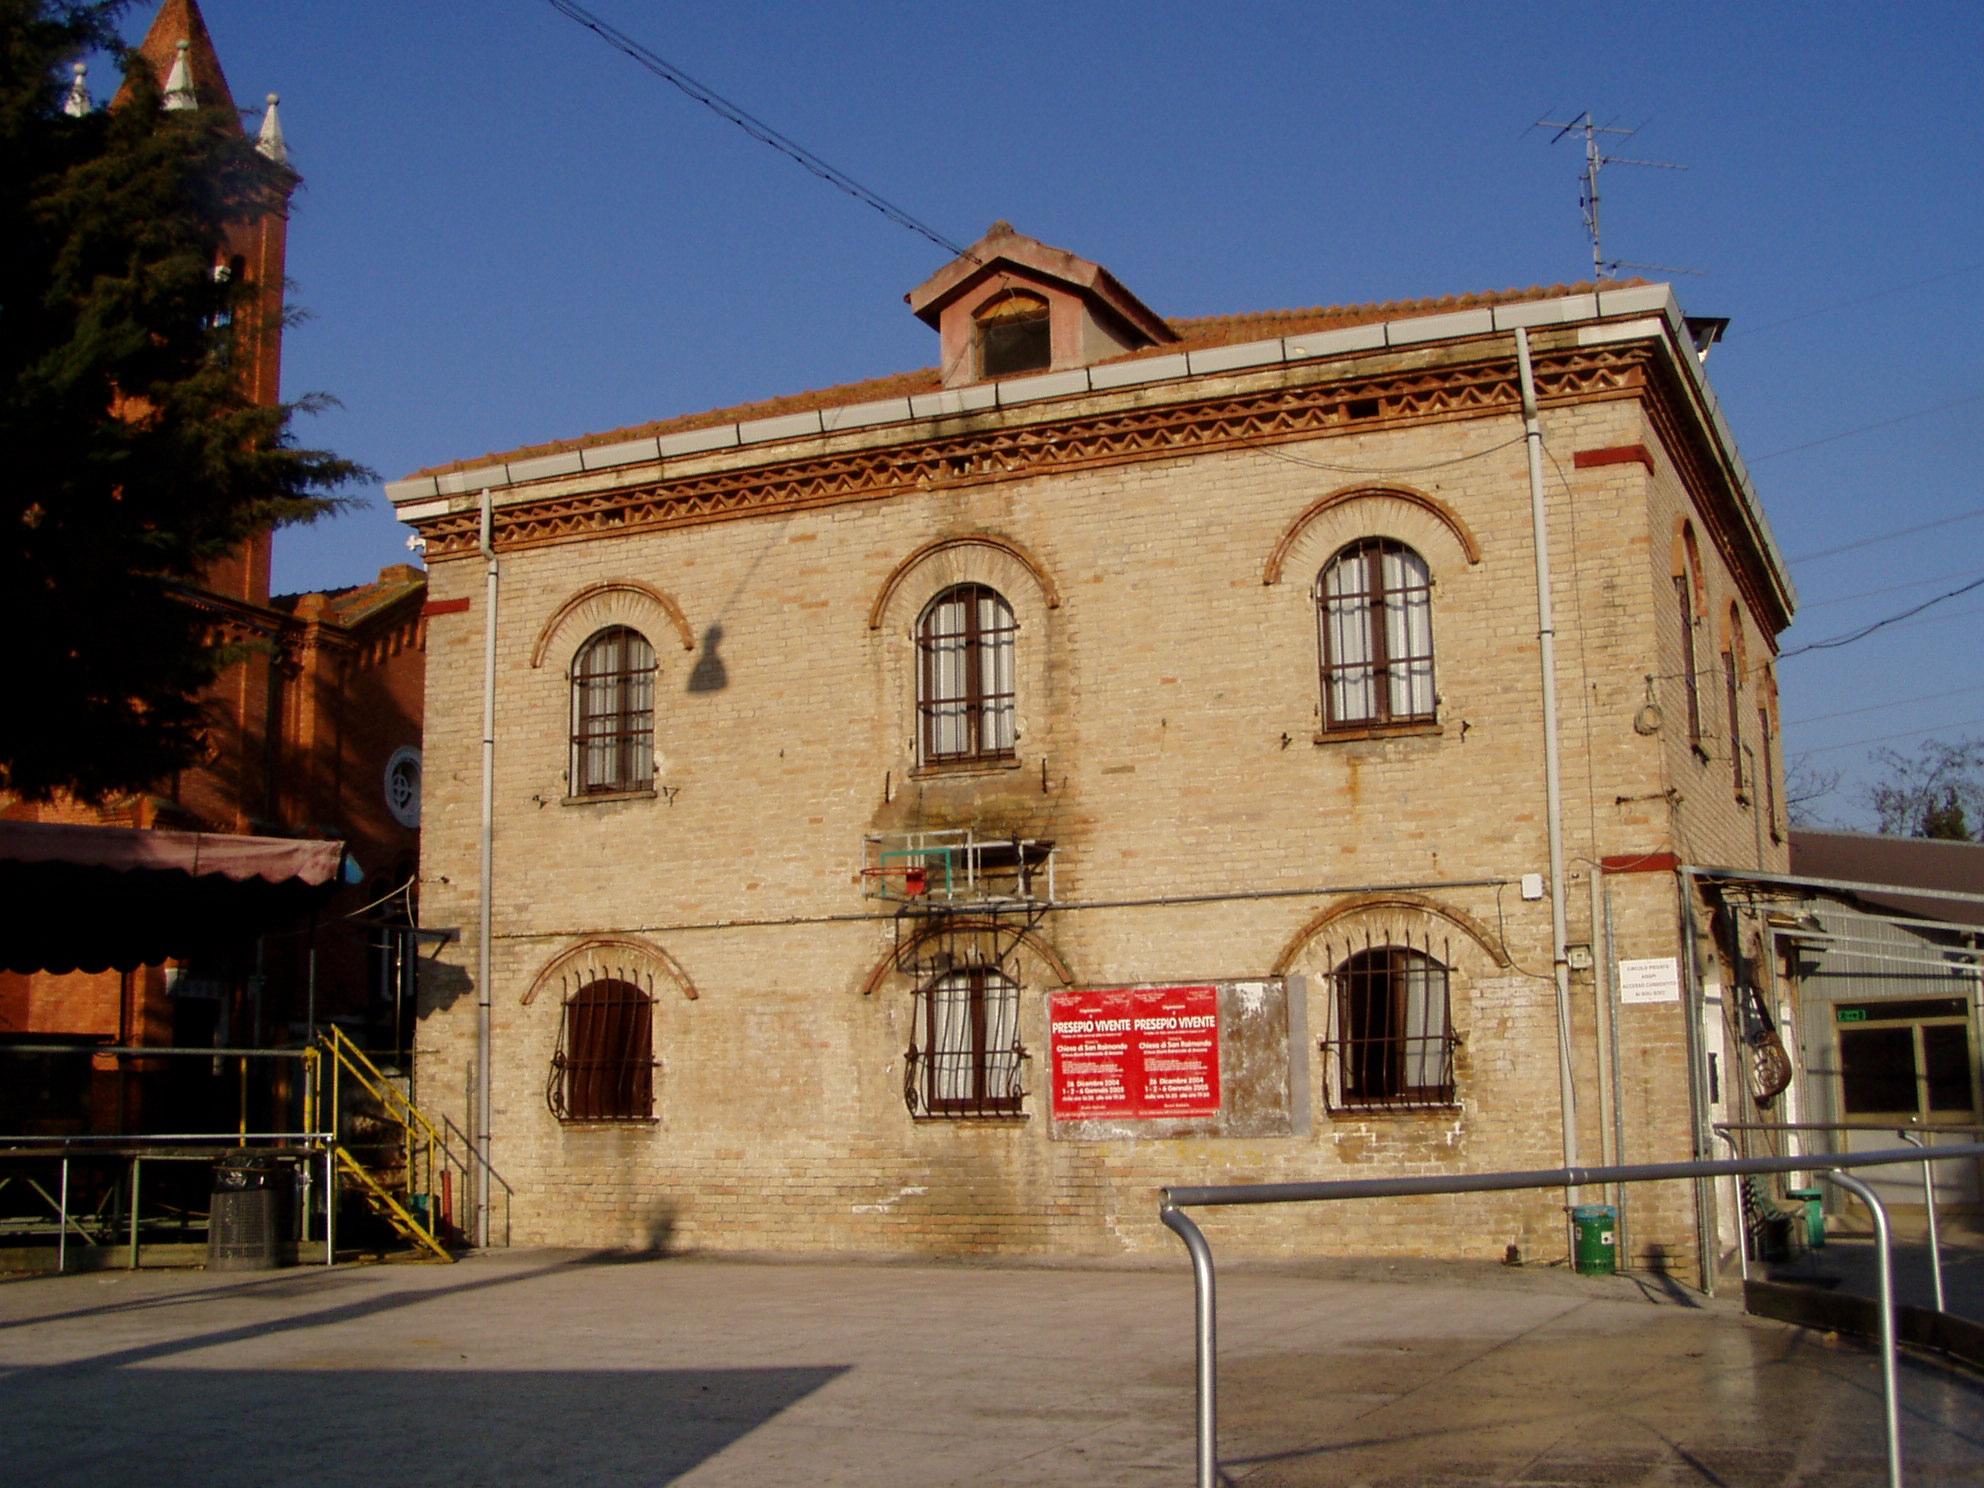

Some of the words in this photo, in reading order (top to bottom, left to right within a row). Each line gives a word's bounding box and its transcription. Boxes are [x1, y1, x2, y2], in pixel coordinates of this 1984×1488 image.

[1052, 1020, 1094, 1034] PRESEPIO
[1095, 1018, 1131, 1032] VIVENTE
[1134, 1017, 1177, 1031] PRESEPIO
[1178, 1015, 1216, 1029] VIVENTE
[1056, 1044, 1077, 1052] Chiesa
[1077, 1043, 1083, 1051] di
[1084, 1043, 1096, 1051] San
[1097, 1042, 1128, 1051] Raimondo
[1138, 1041, 1160, 1050] Chiesa
[1160, 1041, 1167, 1049] di
[1167, 1041, 1180, 1049] San
[1180, 1039, 1212, 1048] Raimondo
[1159, 1077, 1188, 1085] Dicembre
[1167, 1084, 1192, 1092] Gennaio
